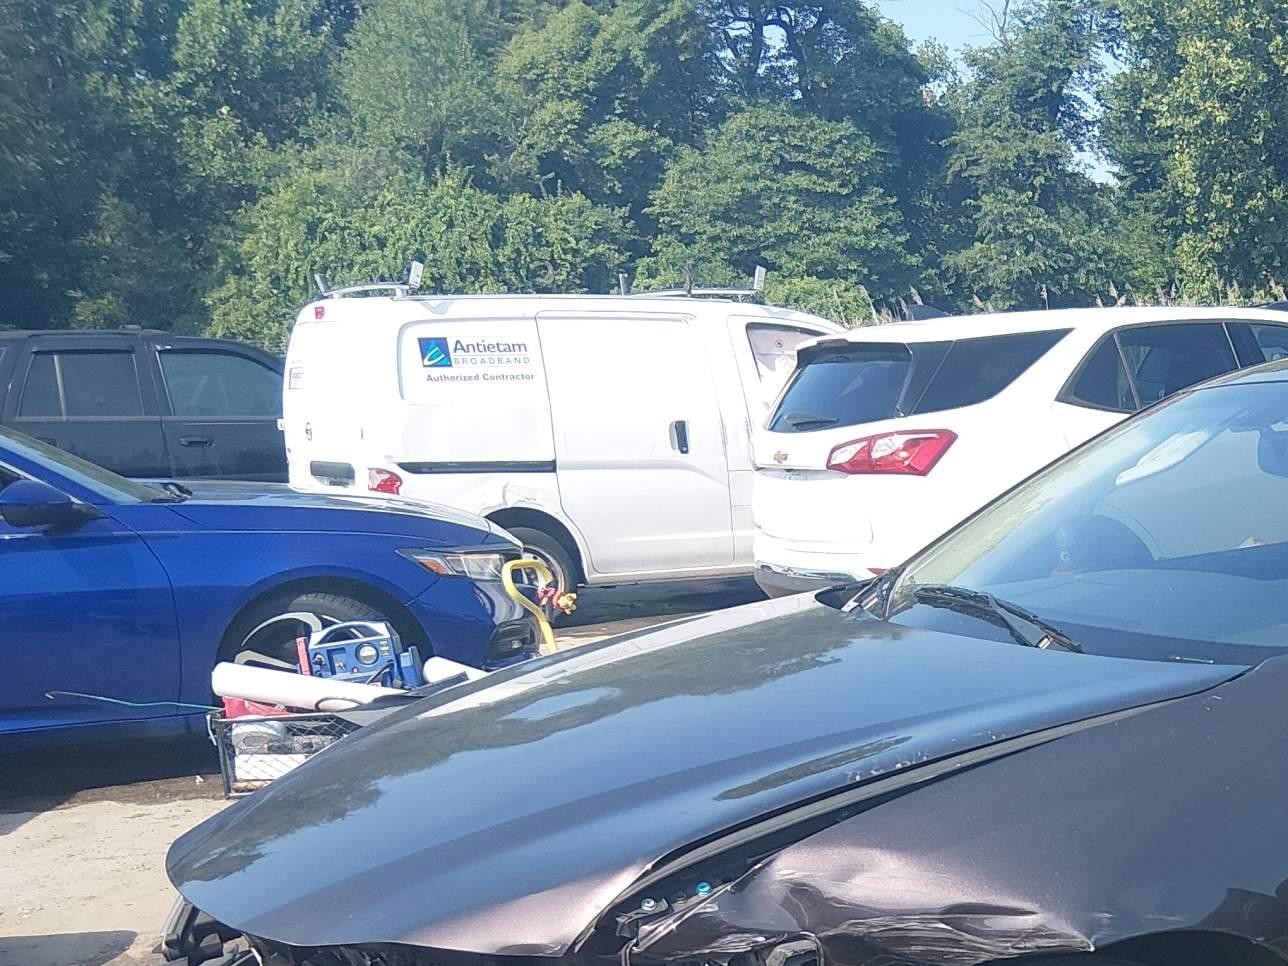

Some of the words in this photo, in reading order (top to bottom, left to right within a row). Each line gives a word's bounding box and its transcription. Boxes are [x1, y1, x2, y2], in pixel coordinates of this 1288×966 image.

[453, 339, 528, 354] Antietam
[454, 357, 531, 366] BROADBAND
[426, 373, 480, 383] Authorized
[482, 373, 535, 382] Contractor
